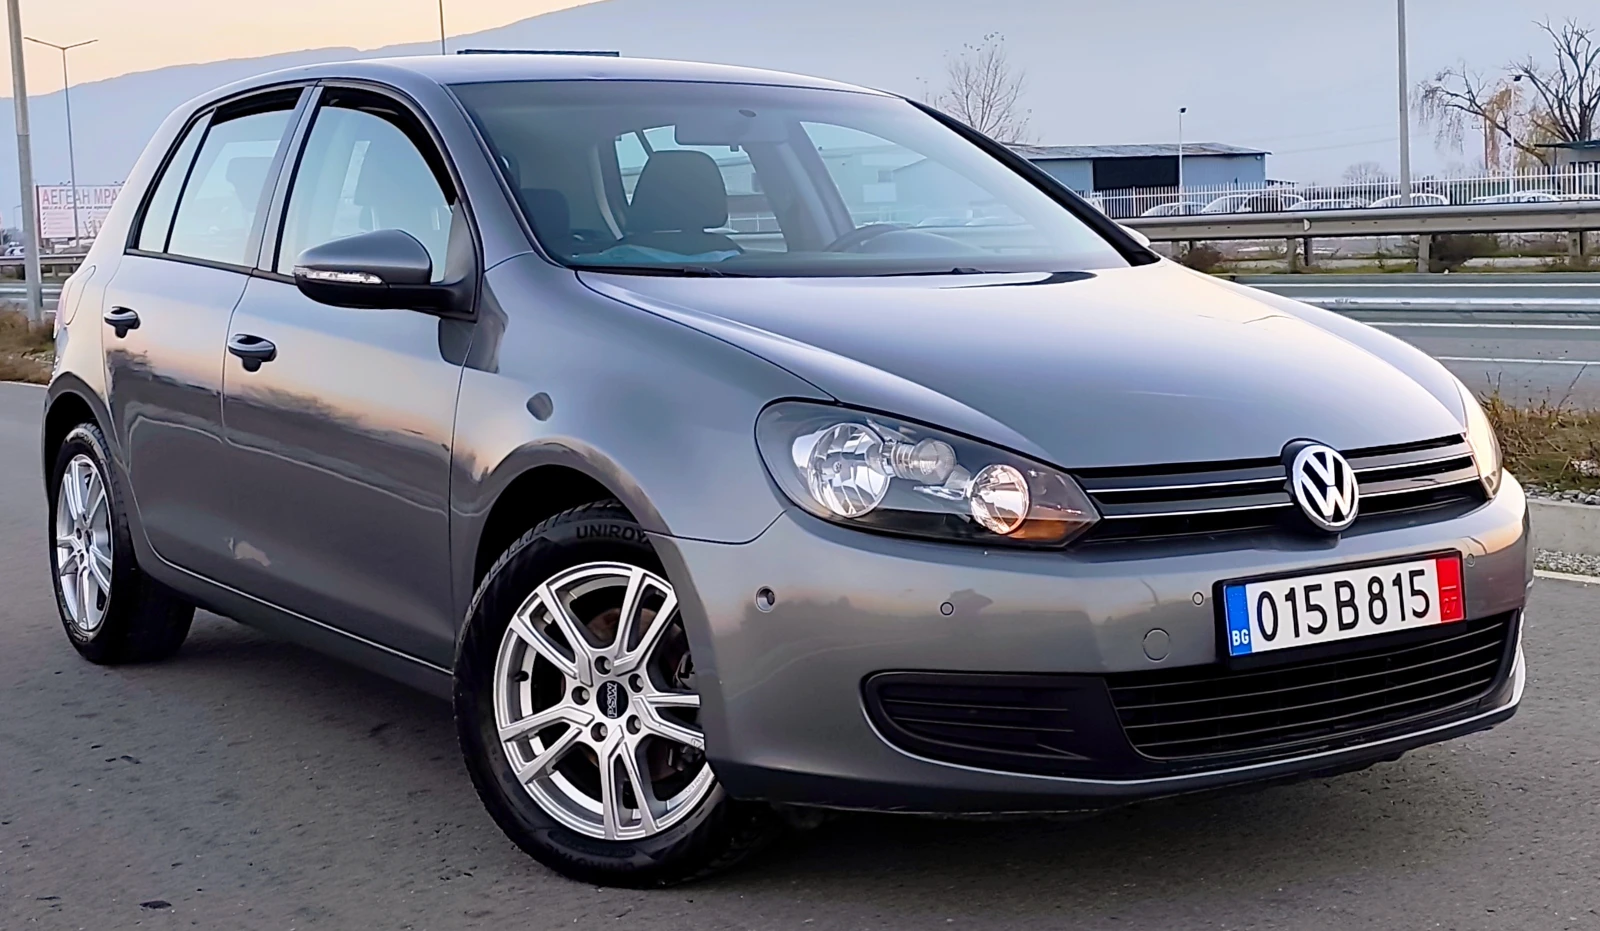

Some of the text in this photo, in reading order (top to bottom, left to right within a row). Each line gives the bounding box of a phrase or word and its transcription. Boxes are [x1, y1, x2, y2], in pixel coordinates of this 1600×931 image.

[94, 189, 121, 205] МРА
[576, 524, 648, 543] UNIROY
[1231, 629, 1249, 647] BG
